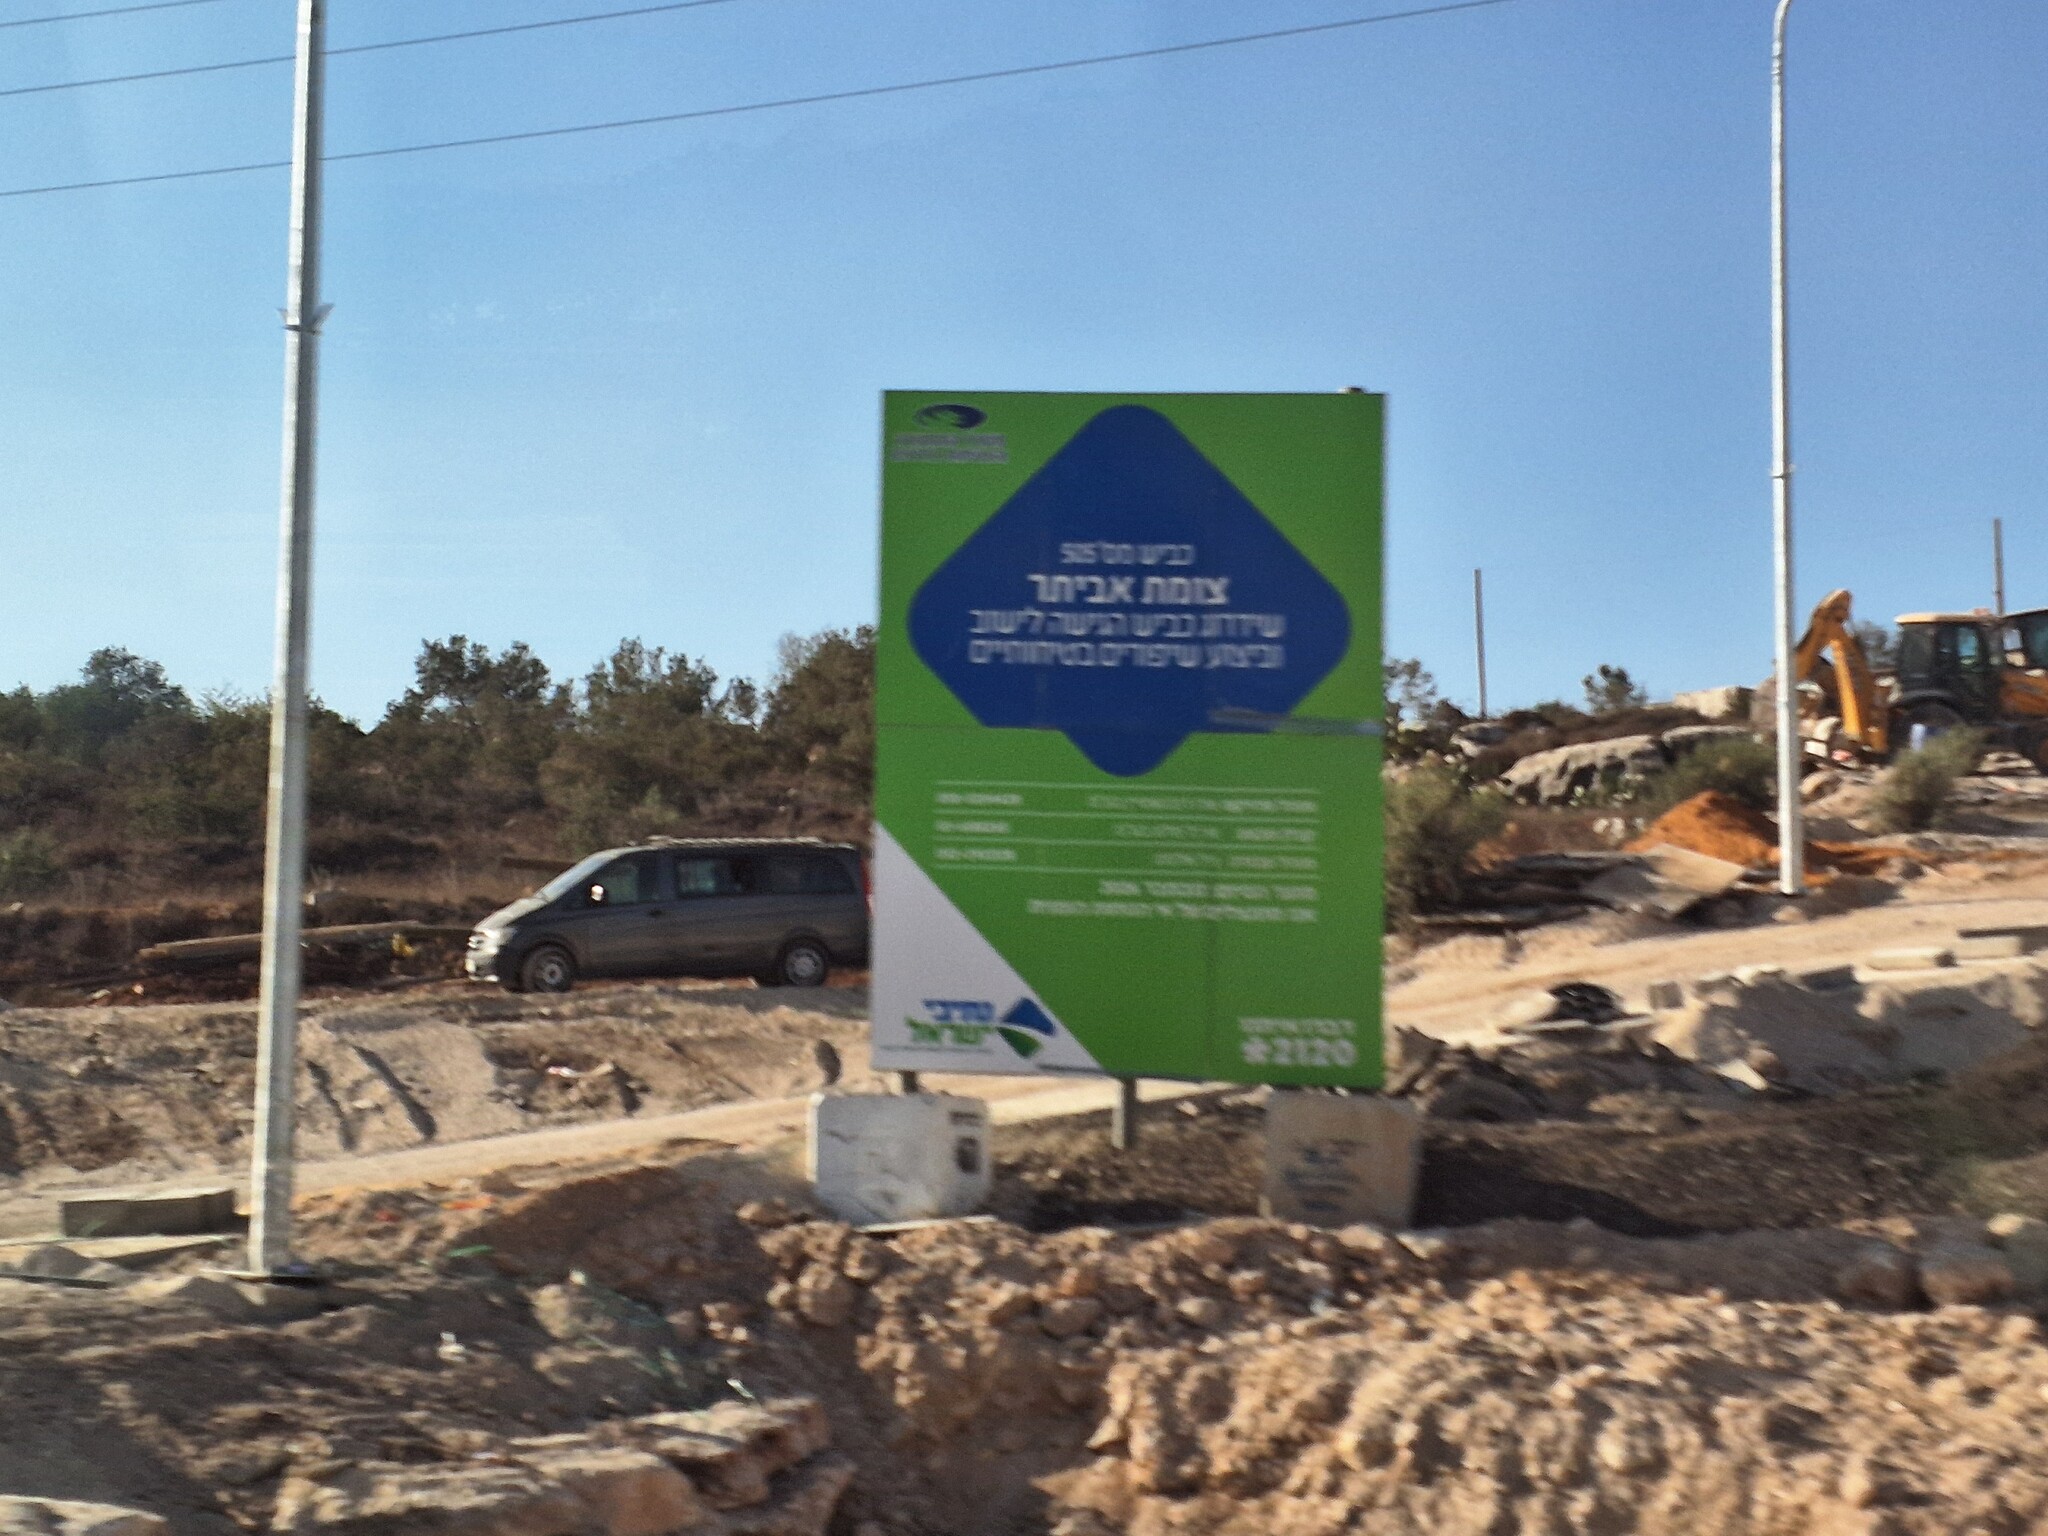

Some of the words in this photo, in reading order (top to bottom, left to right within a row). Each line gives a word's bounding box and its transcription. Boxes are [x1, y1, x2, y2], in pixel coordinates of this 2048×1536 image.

[1137, 544, 1196, 566] כביש
[1026, 573, 1136, 604] אביתר
[1139, 576, 1230, 605] צומת
[1047, 611, 1127, 636] הגישה
[1128, 613, 1198, 638] כביש
